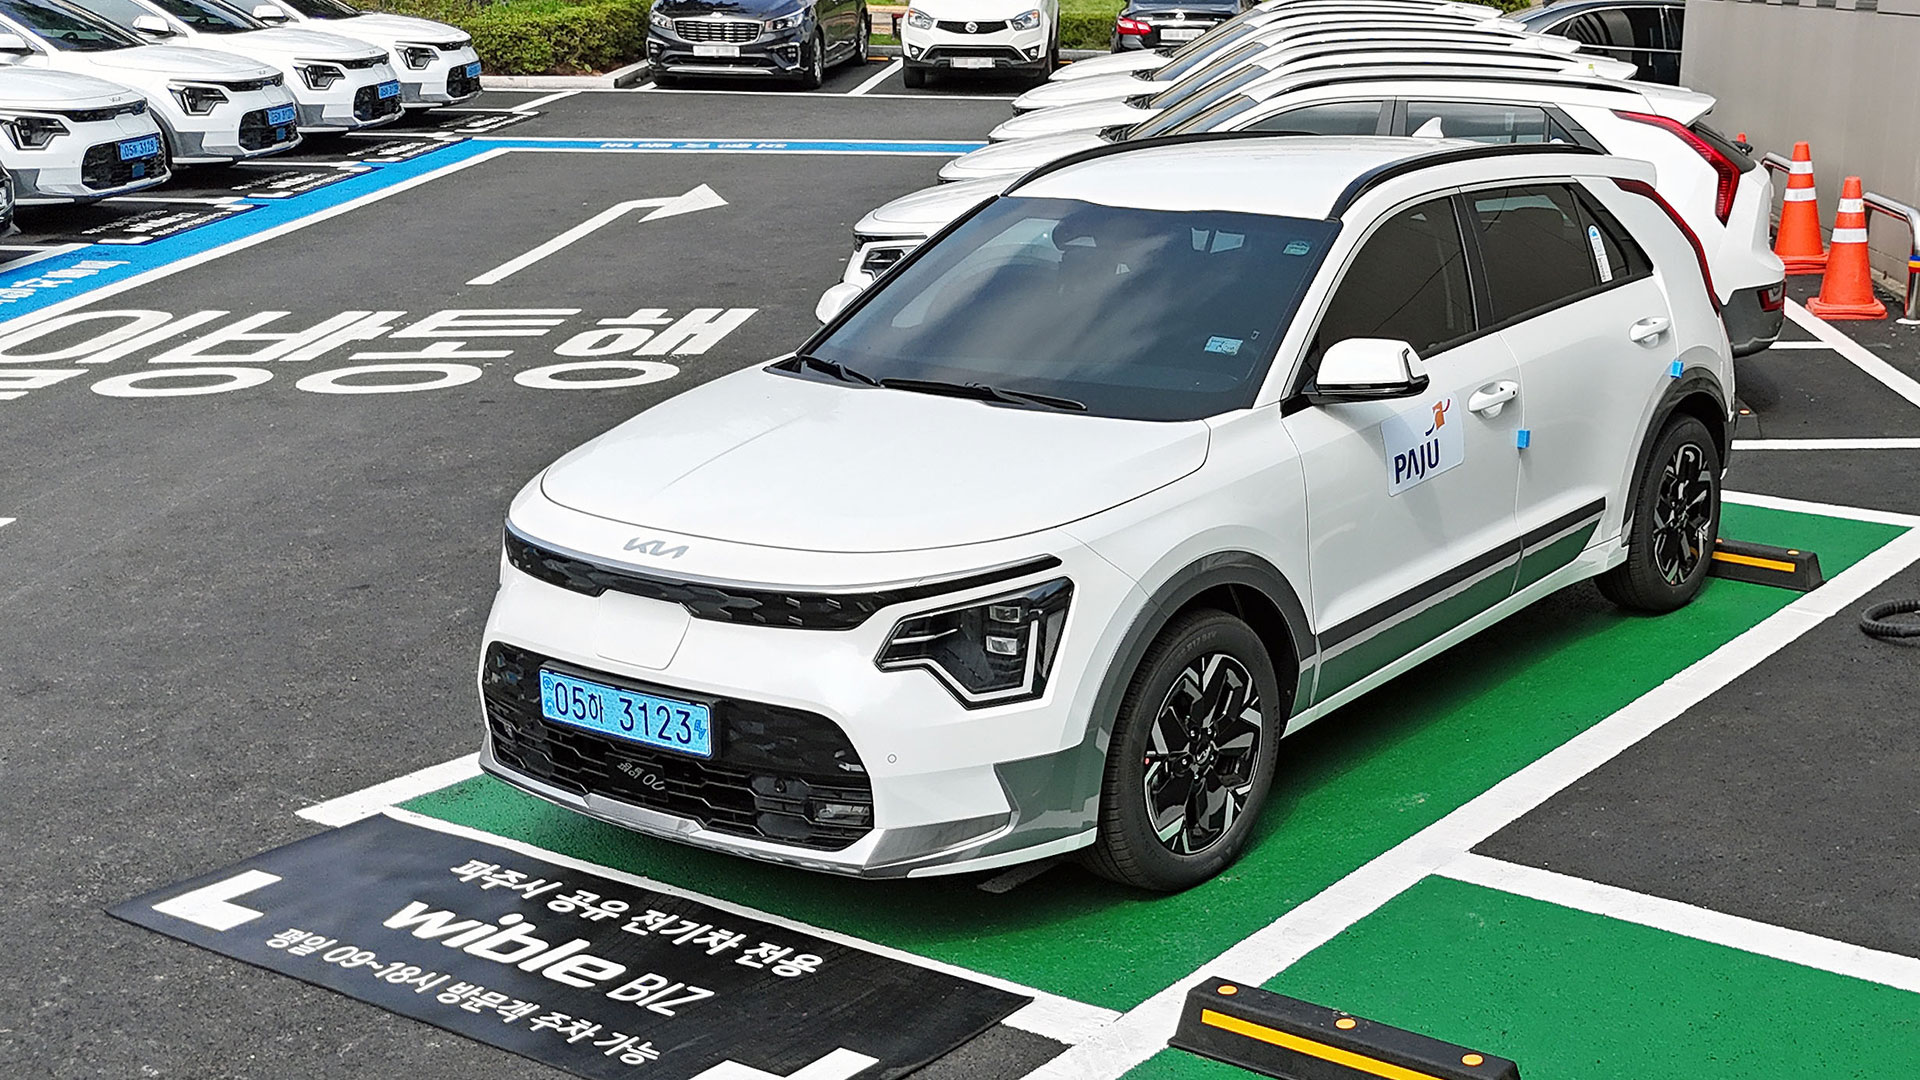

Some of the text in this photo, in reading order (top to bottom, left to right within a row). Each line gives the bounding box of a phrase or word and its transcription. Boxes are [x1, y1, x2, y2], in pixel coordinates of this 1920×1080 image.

[1394, 438, 1440, 485] PAJU
[555, 682, 691, 744] 05하 3123
[383, 901, 715, 1017] wible BIZ
[450, 859, 824, 977] 파주시 공유 전기차 전용
[266, 928, 660, 1065] 평일 09~18시 방문객 주차 가능
